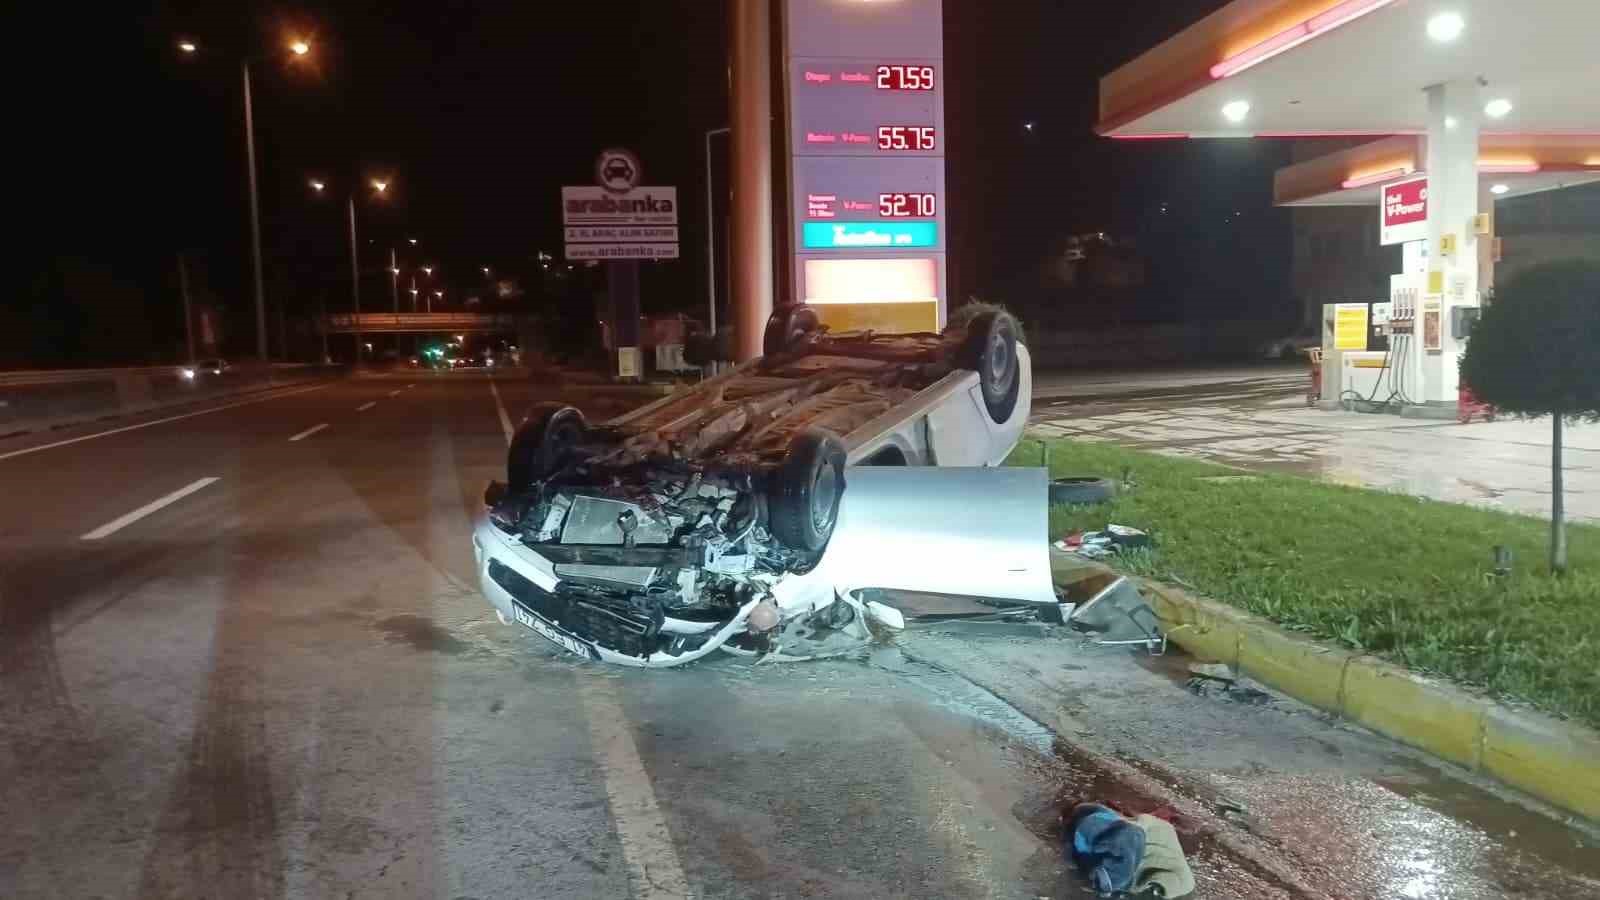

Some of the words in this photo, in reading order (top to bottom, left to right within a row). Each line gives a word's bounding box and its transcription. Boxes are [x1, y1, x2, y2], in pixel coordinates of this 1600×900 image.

[877, 66, 934, 90] 27.59
[878, 126, 935, 150] 55.75
[567, 194, 673, 212] arabanka
[879, 193, 936, 216] 52.70
[1386, 202, 1425, 217] V-Power
